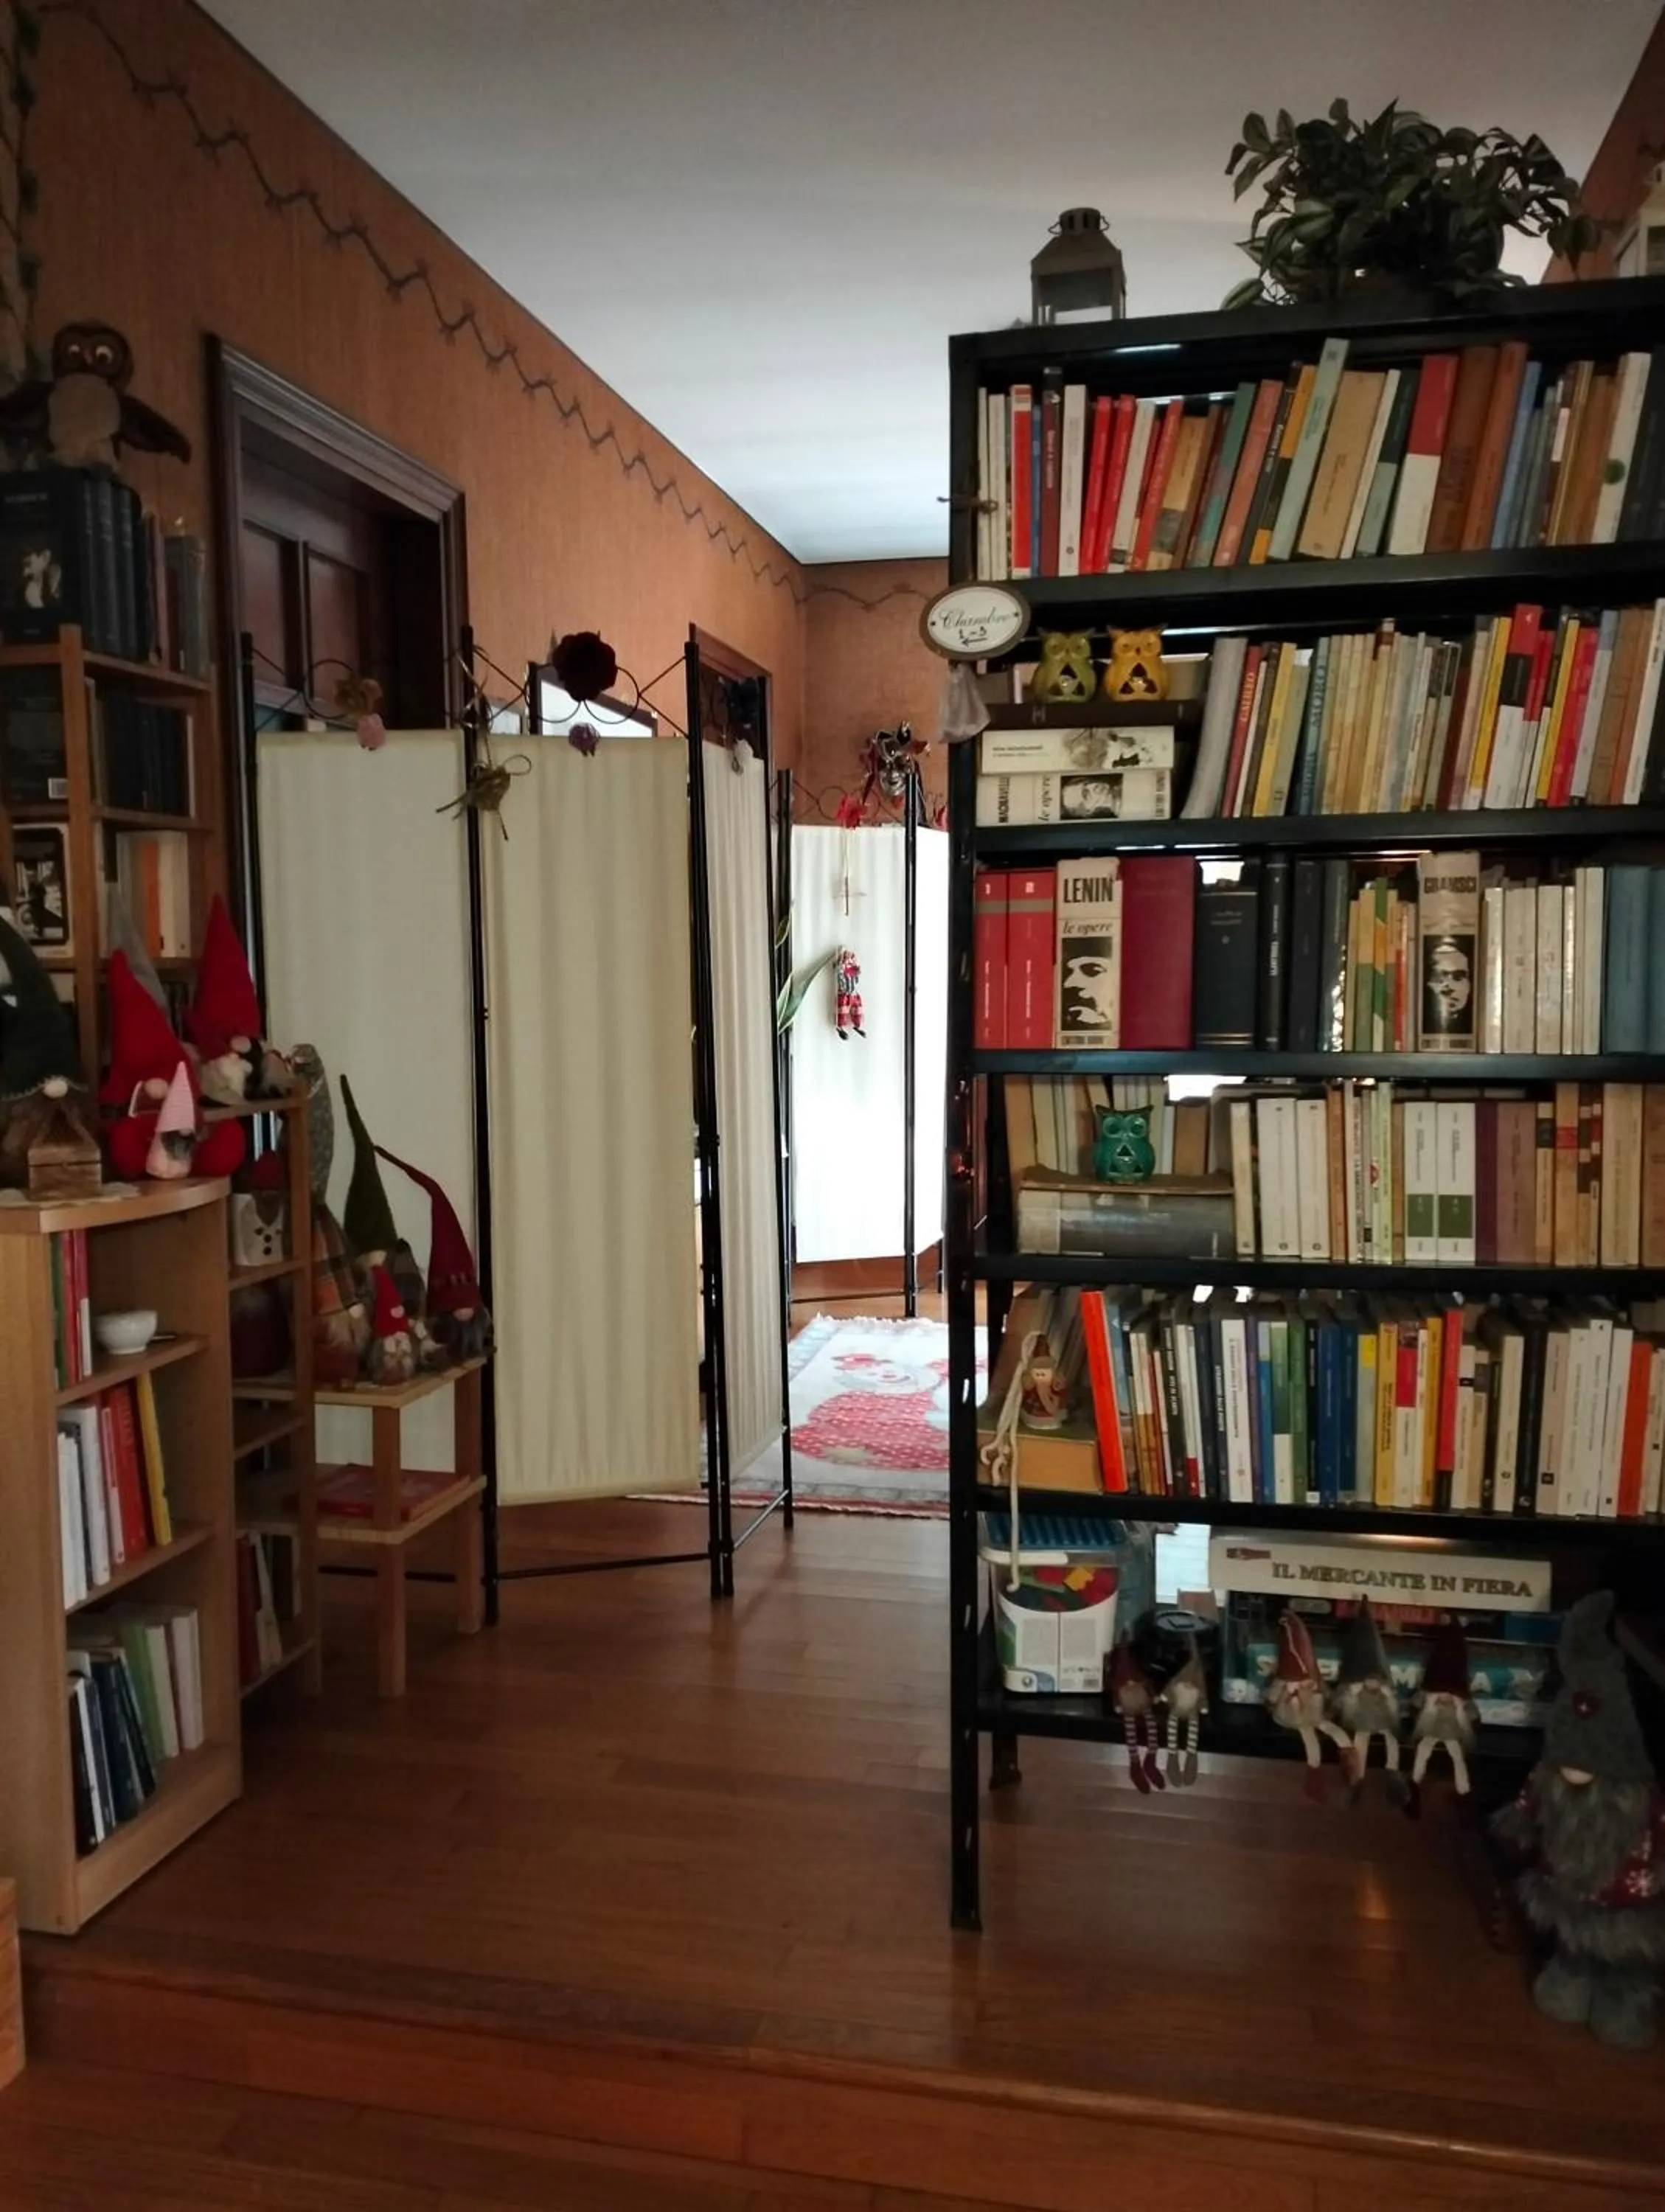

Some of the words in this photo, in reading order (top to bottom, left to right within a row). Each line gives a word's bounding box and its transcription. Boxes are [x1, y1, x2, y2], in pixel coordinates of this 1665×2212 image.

[1063, 877, 1113, 903] LENIN
[1063, 920, 1075, 934] le
[1272, 1561, 1296, 1579] IL
[1299, 1564, 1426, 1591] MERCANTE
[1431, 1573, 1457, 1593] IN
[1461, 1576, 1534, 1598] FIERA
